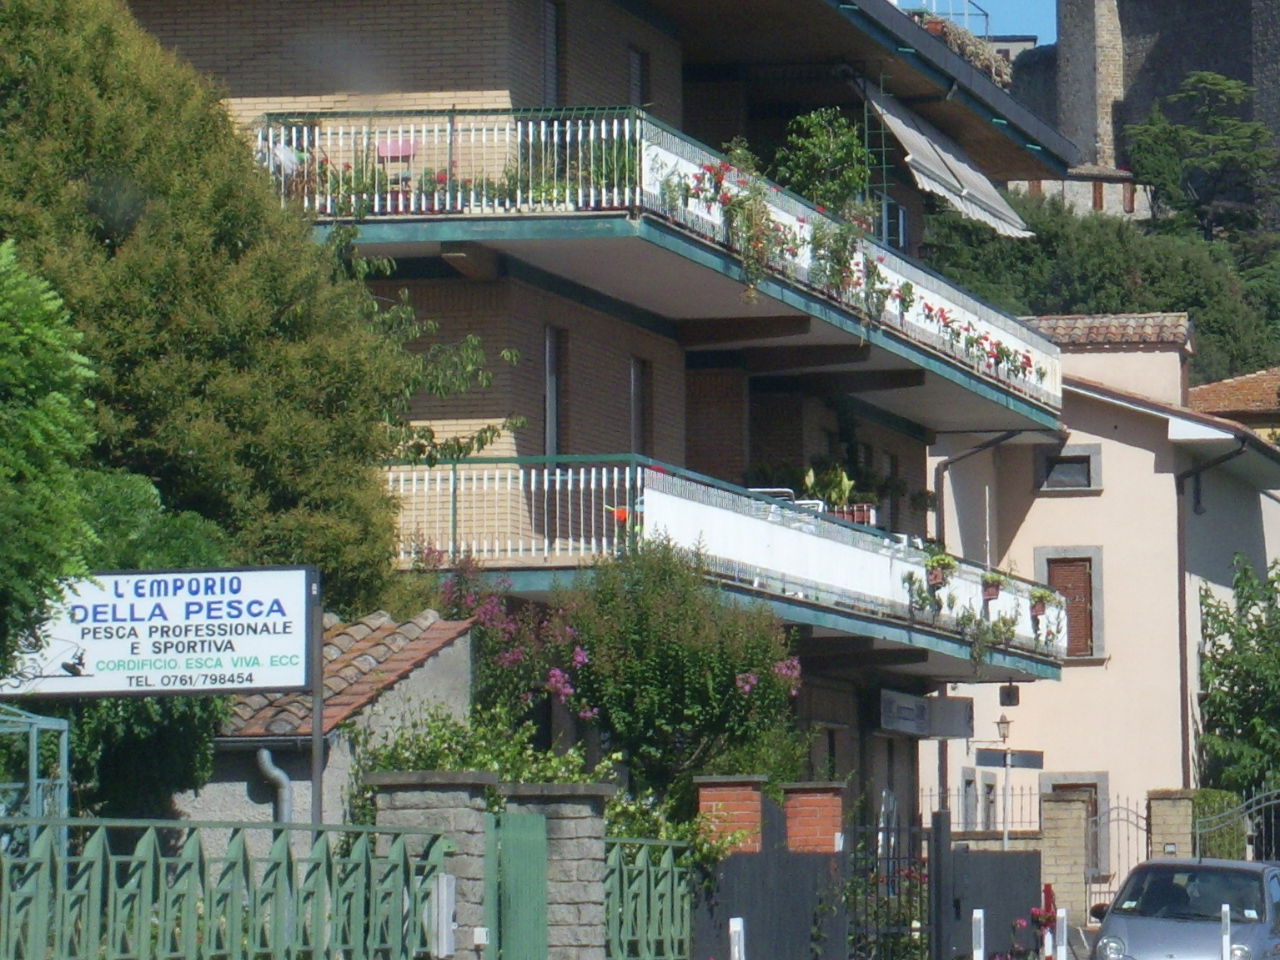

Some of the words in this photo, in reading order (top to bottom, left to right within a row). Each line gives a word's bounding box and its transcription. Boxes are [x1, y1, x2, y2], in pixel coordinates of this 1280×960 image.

[114, 576, 242, 598] L'EMPORIO
[70, 602, 169, 624] DELLA
[185, 598, 287, 620] PESCA
[81, 626, 139, 640] PESCA
[148, 621, 293, 638] PROFESSIONALE
[131, 642, 140, 655] E
[152, 639, 236, 654] SPORTIVA
[185, 657, 223, 669] ESCA
[270, 654, 300, 667] ECC
[127, 674, 156, 687] TEL.
[161, 672, 254, 687] 0761/798454
